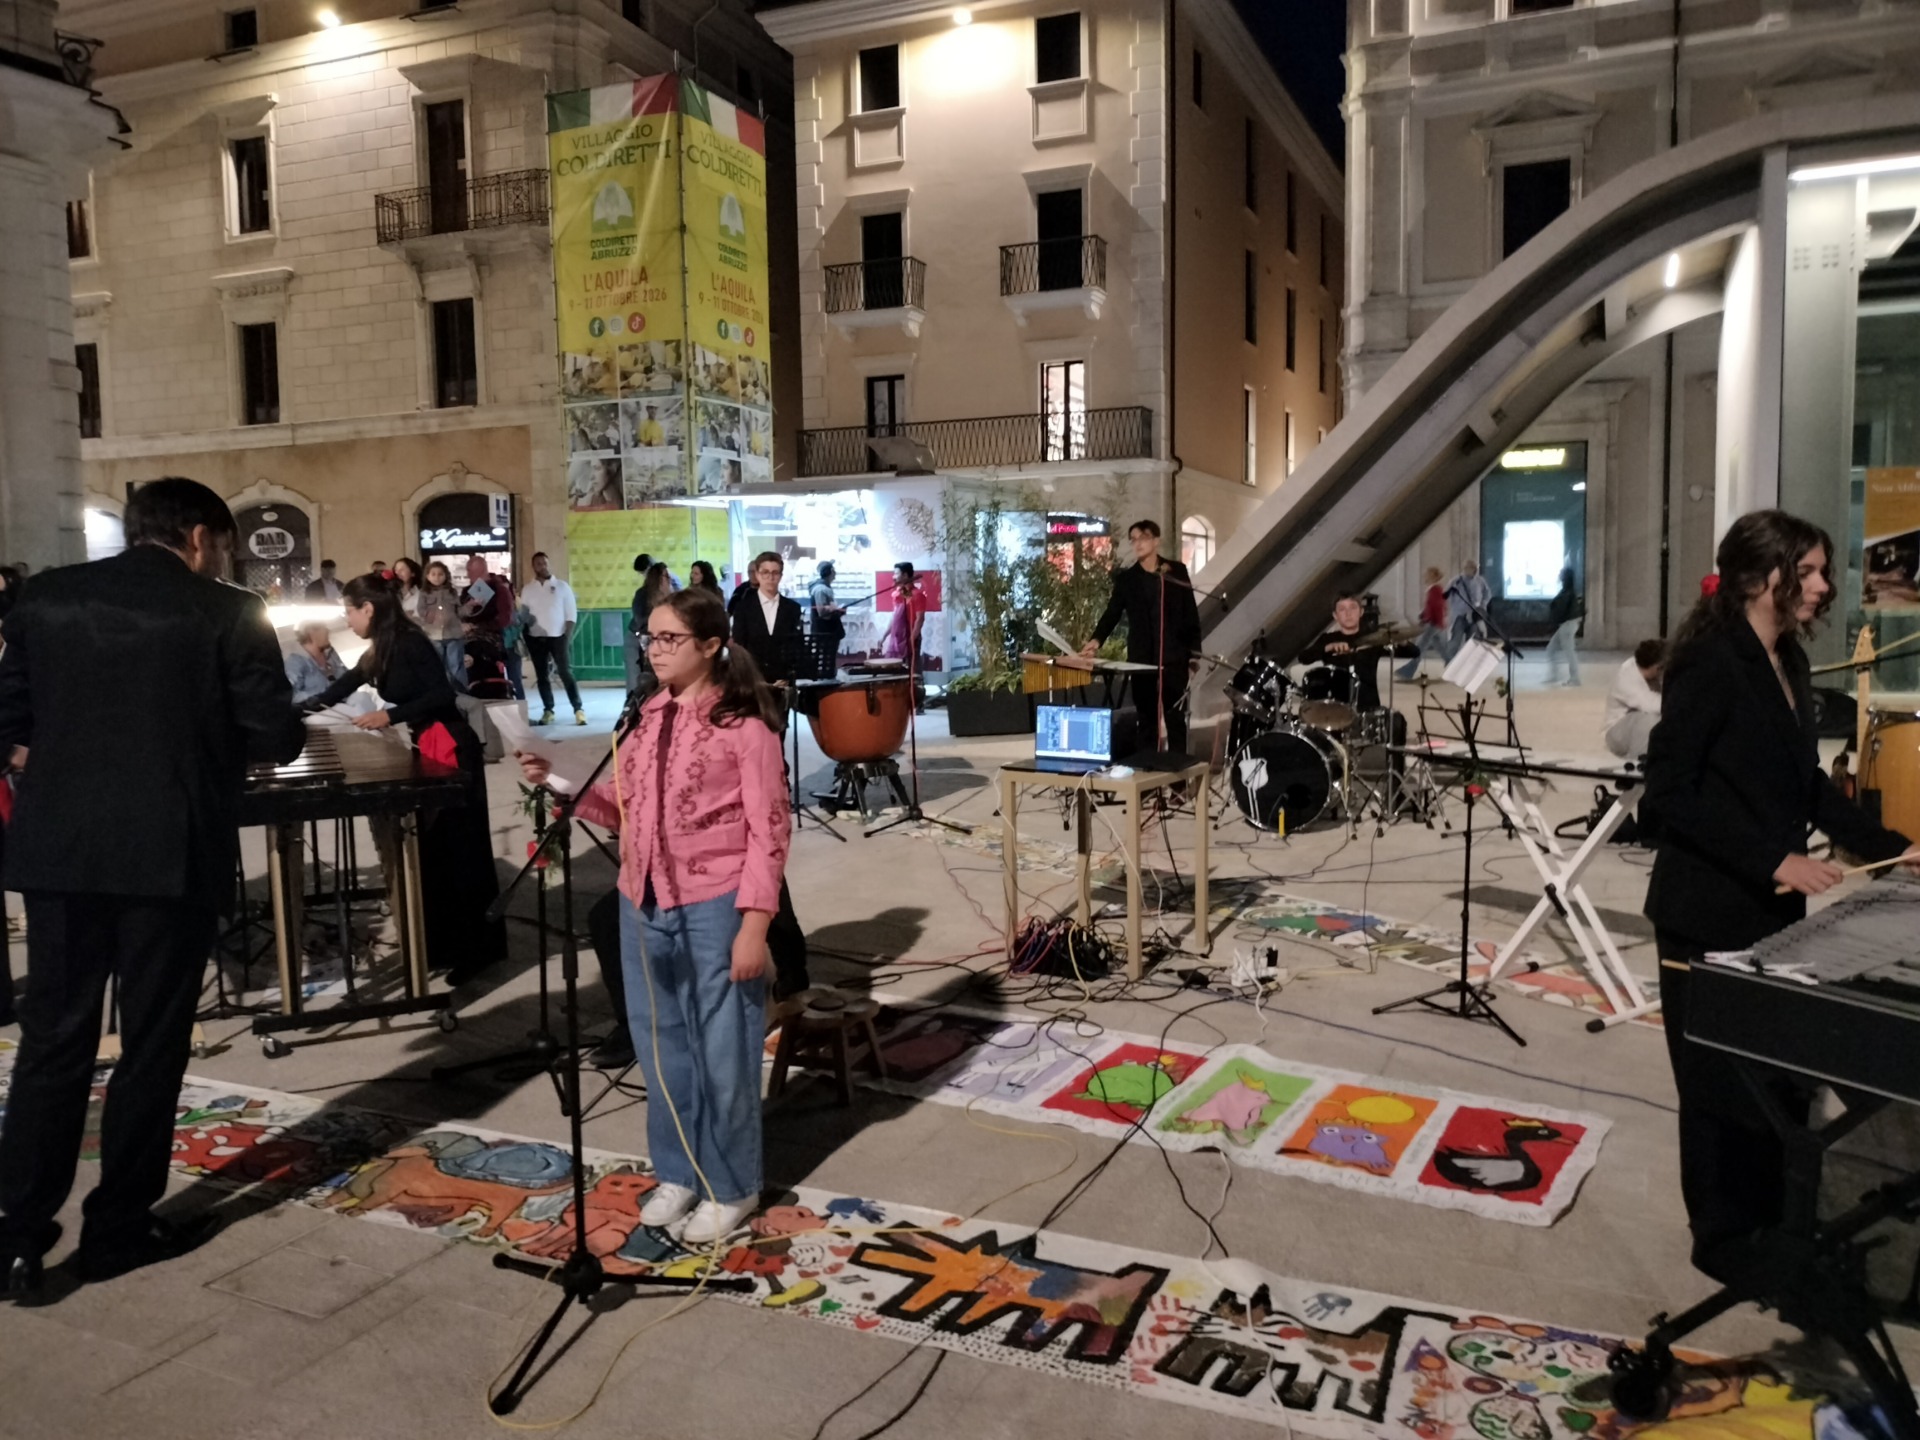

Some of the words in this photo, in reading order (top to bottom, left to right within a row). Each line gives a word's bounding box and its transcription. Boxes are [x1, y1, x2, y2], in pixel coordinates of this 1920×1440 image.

[572, 123, 653, 150] VILLAGGIO
[556, 139, 672, 177] COLDIRETTI
[686, 144, 763, 198] COLDIRETTI
[590, 233, 638, 249] COLDIRETTI
[591, 246, 638, 261] ABRUZZO
[718, 253, 748, 272] ABRUZZO
[583, 265, 649, 292] L'AQUILA
[711, 271, 756, 305] L'AQUILA
[595, 290, 639, 309] OTTOBRE
[642, 287, 668, 302] 2026
[698, 291, 704, 305] 9
[713, 295, 720, 310] 11
[254, 531, 287, 547] BAR
